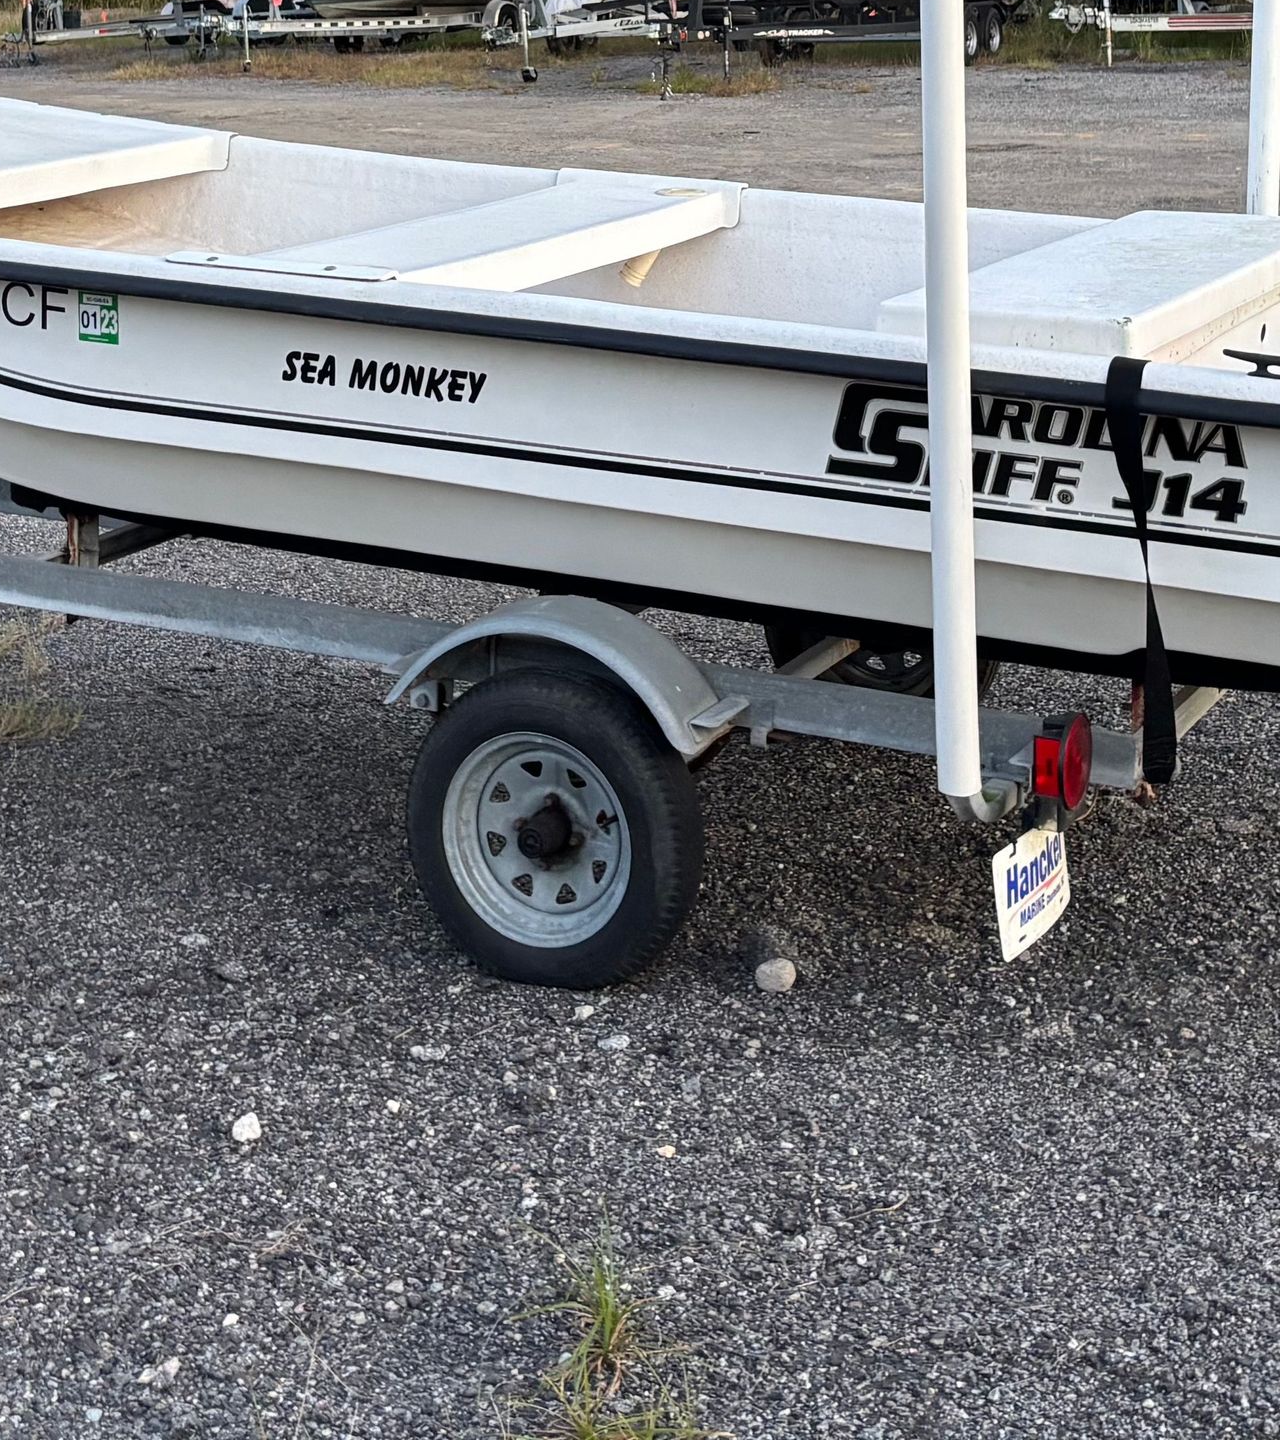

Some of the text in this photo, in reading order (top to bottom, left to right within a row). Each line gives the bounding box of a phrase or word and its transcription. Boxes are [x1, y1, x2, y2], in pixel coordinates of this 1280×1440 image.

[1, 281, 69, 330] CF
[81, 309, 118, 335] 01 23
[282, 351, 487, 404] SEA MONKEY
[833, 380, 1248, 469] CROLNA
